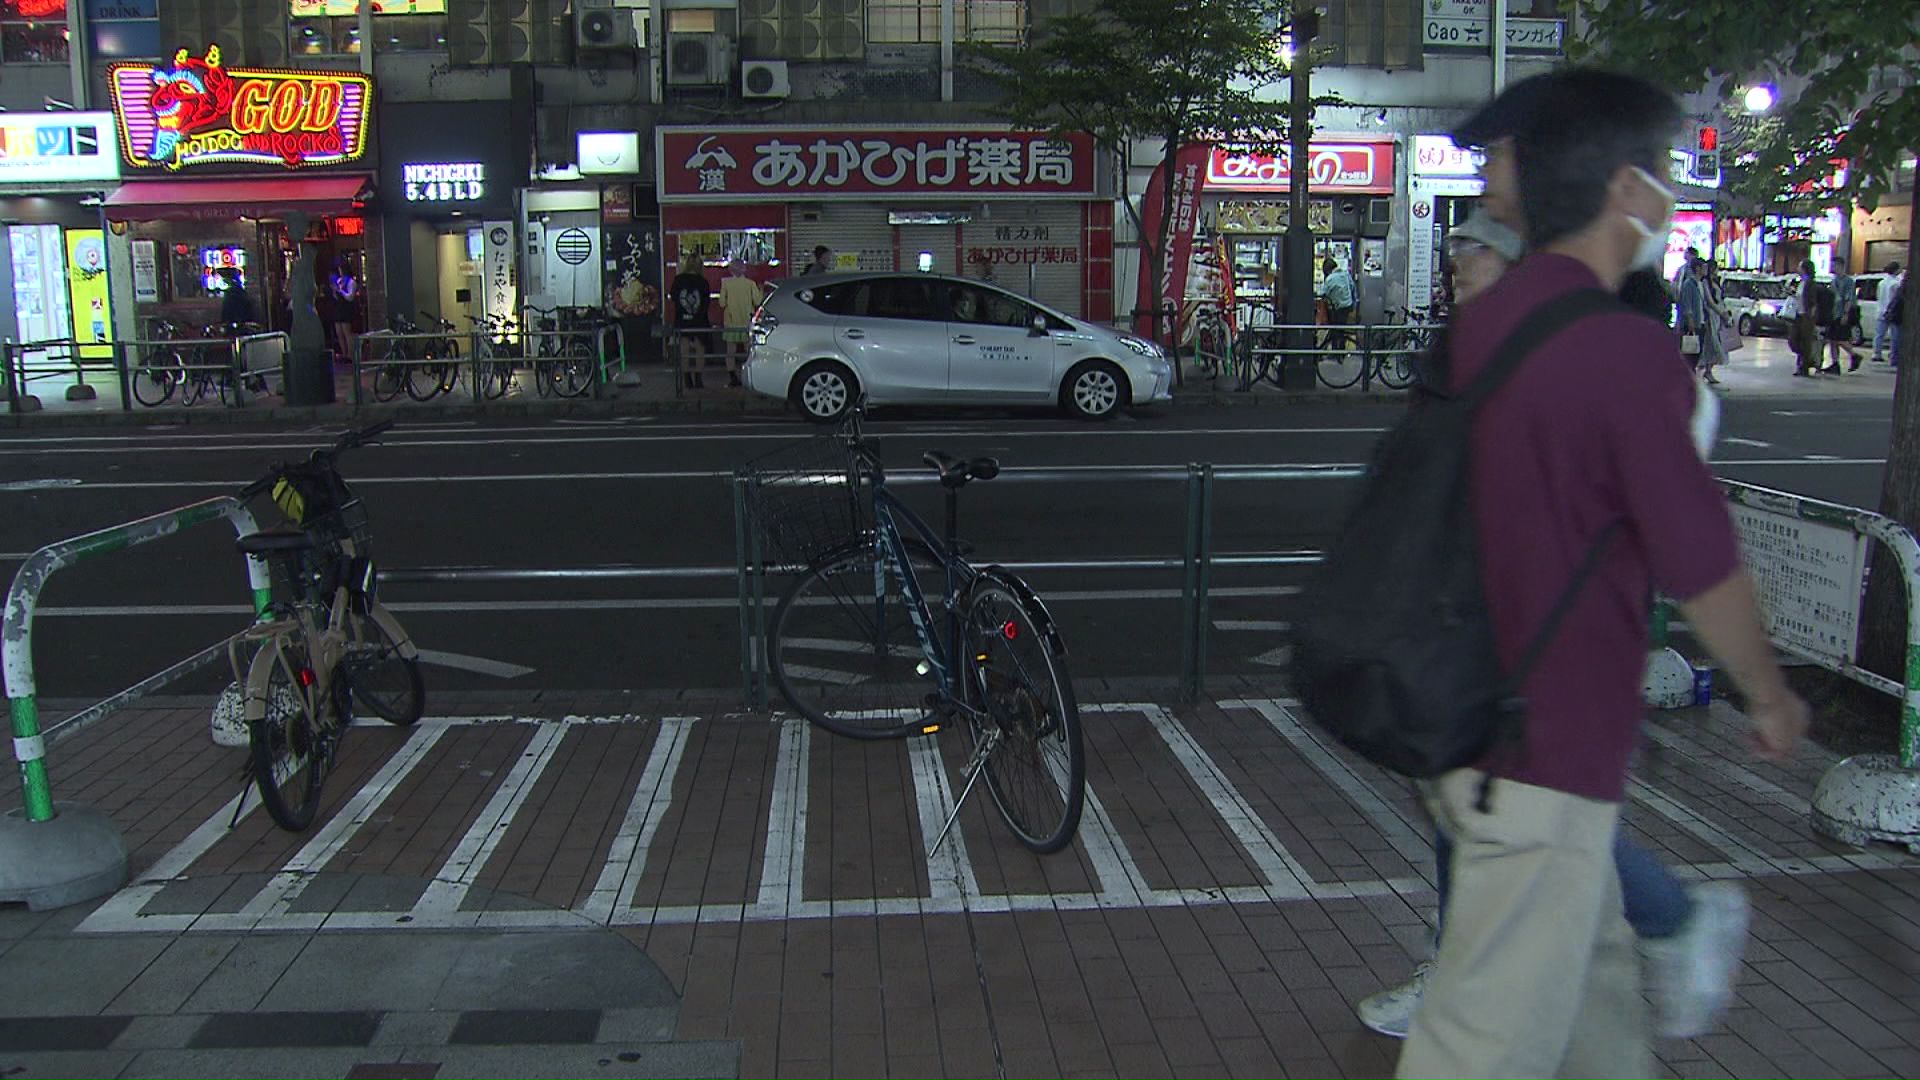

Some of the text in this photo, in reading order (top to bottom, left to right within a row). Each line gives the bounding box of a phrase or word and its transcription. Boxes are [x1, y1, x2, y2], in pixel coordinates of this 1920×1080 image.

[1427, 22, 1459, 41] Cao
[232, 79, 343, 134] GOD
[752, 138, 1073, 186] あかひげ薬局
[1222, 151, 1342, 185] みよの
[966, 245, 1078, 264] あかひげ薬局
